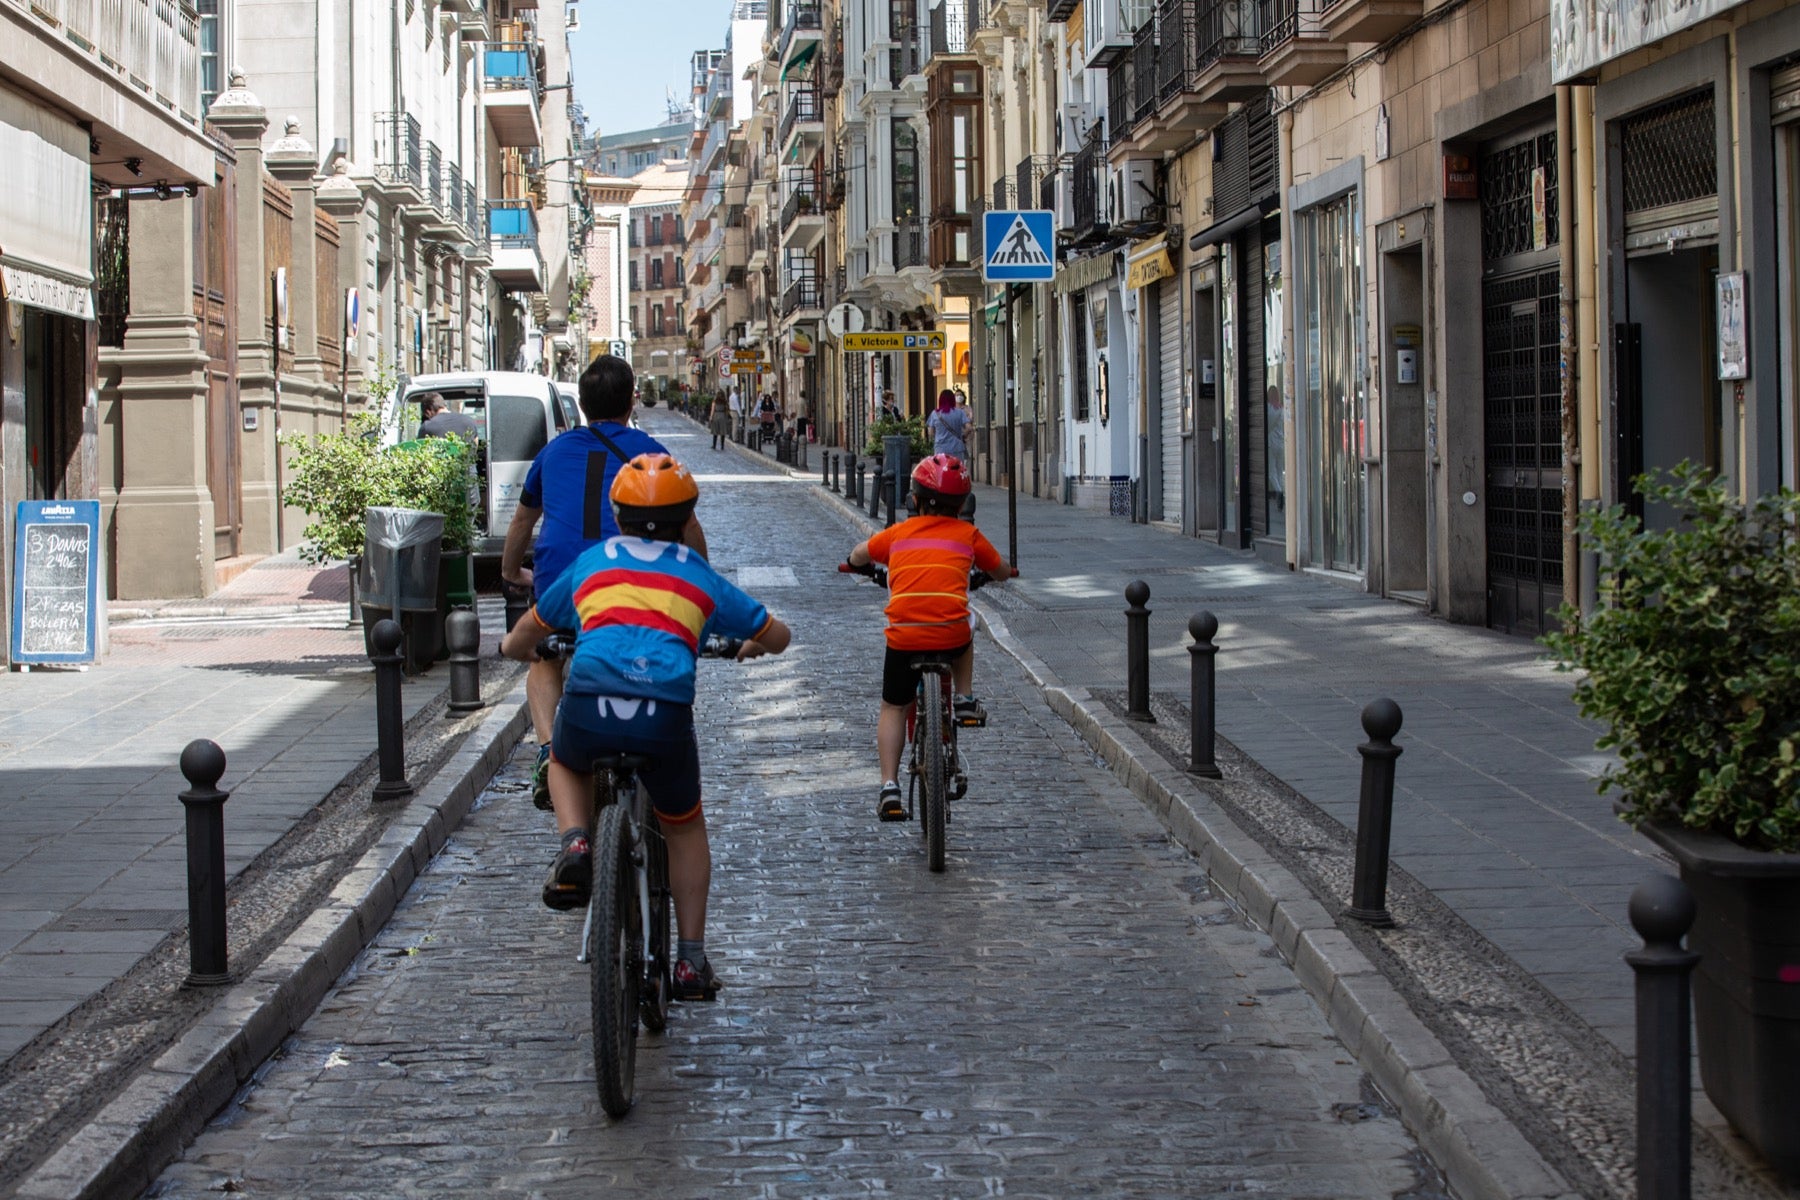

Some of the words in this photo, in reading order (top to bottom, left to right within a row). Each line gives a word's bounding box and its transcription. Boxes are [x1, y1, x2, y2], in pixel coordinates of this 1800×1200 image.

[1449, 173, 1475, 182] FUEGO
[845, 338, 857, 346] H.
[861, 337, 899, 346] Victoria
[31, 534, 43, 553] 3
